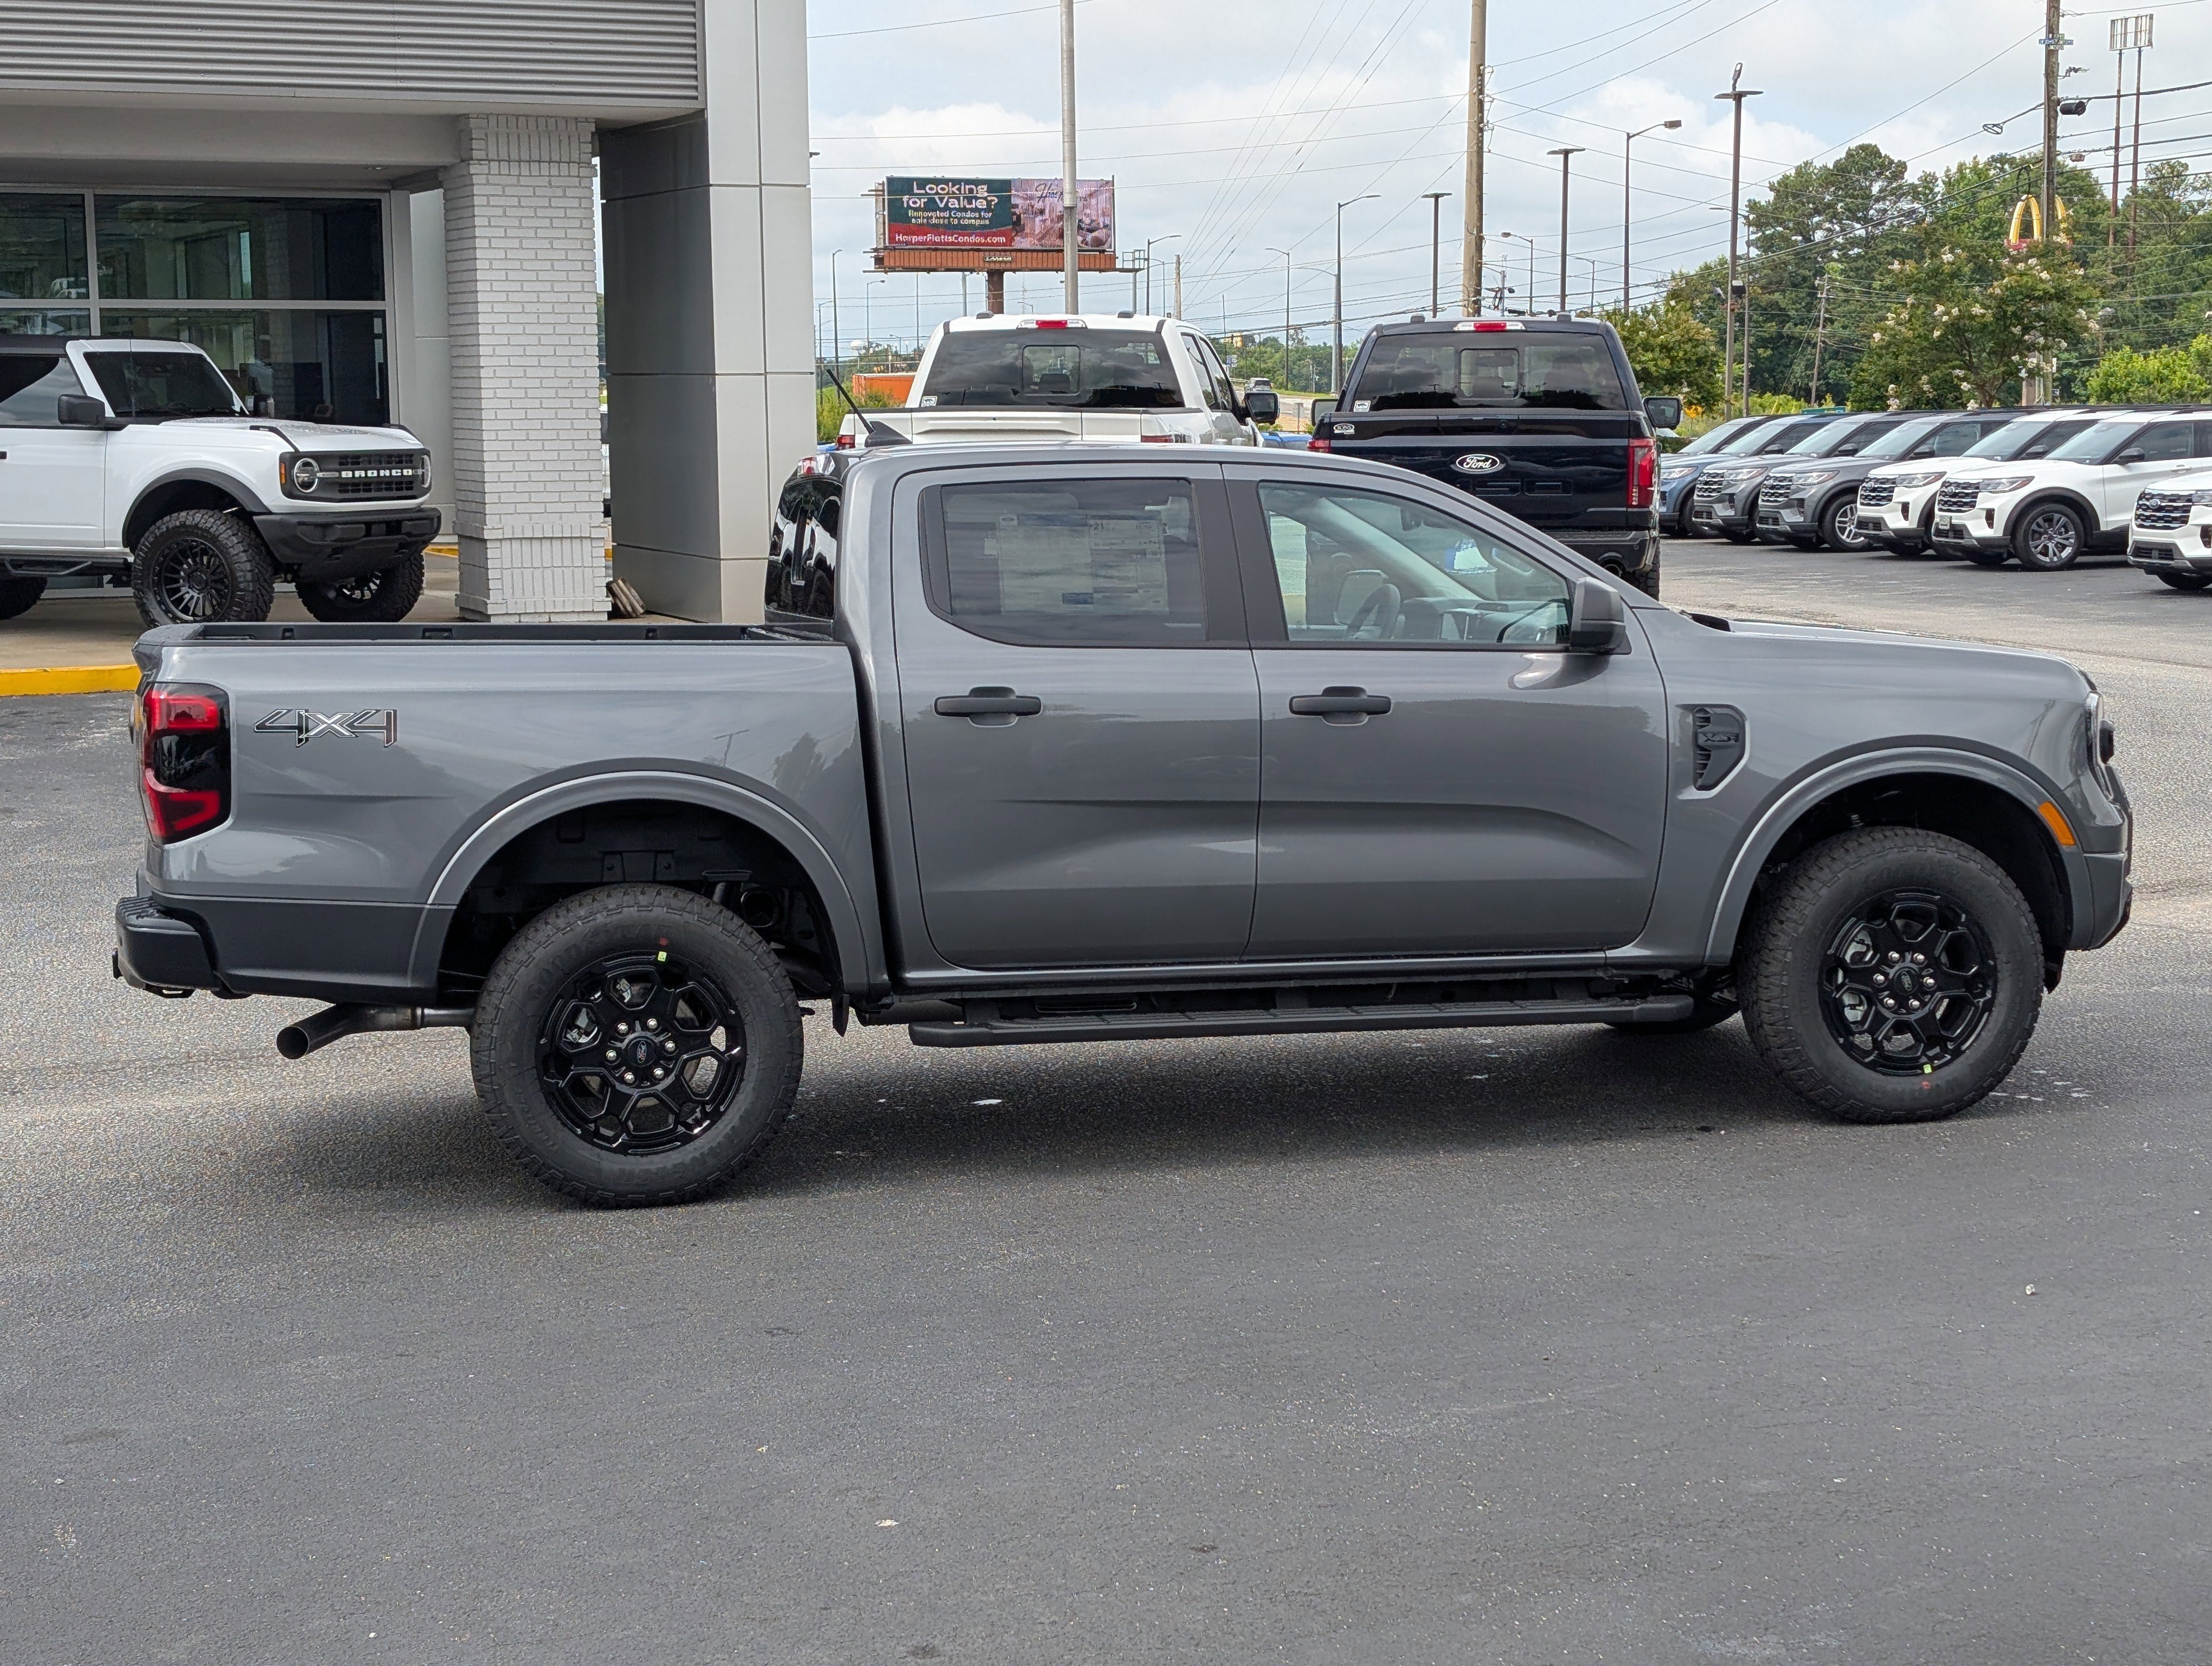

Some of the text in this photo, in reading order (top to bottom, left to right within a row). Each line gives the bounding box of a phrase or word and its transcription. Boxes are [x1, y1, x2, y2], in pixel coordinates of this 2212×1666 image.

[913, 181, 988, 197] Looking
[903, 195, 998, 209] for Value?
[908, 209, 949, 217] Renovated
[1463, 456, 1492, 468] Ford
[342, 469, 412, 478] BRONCO
